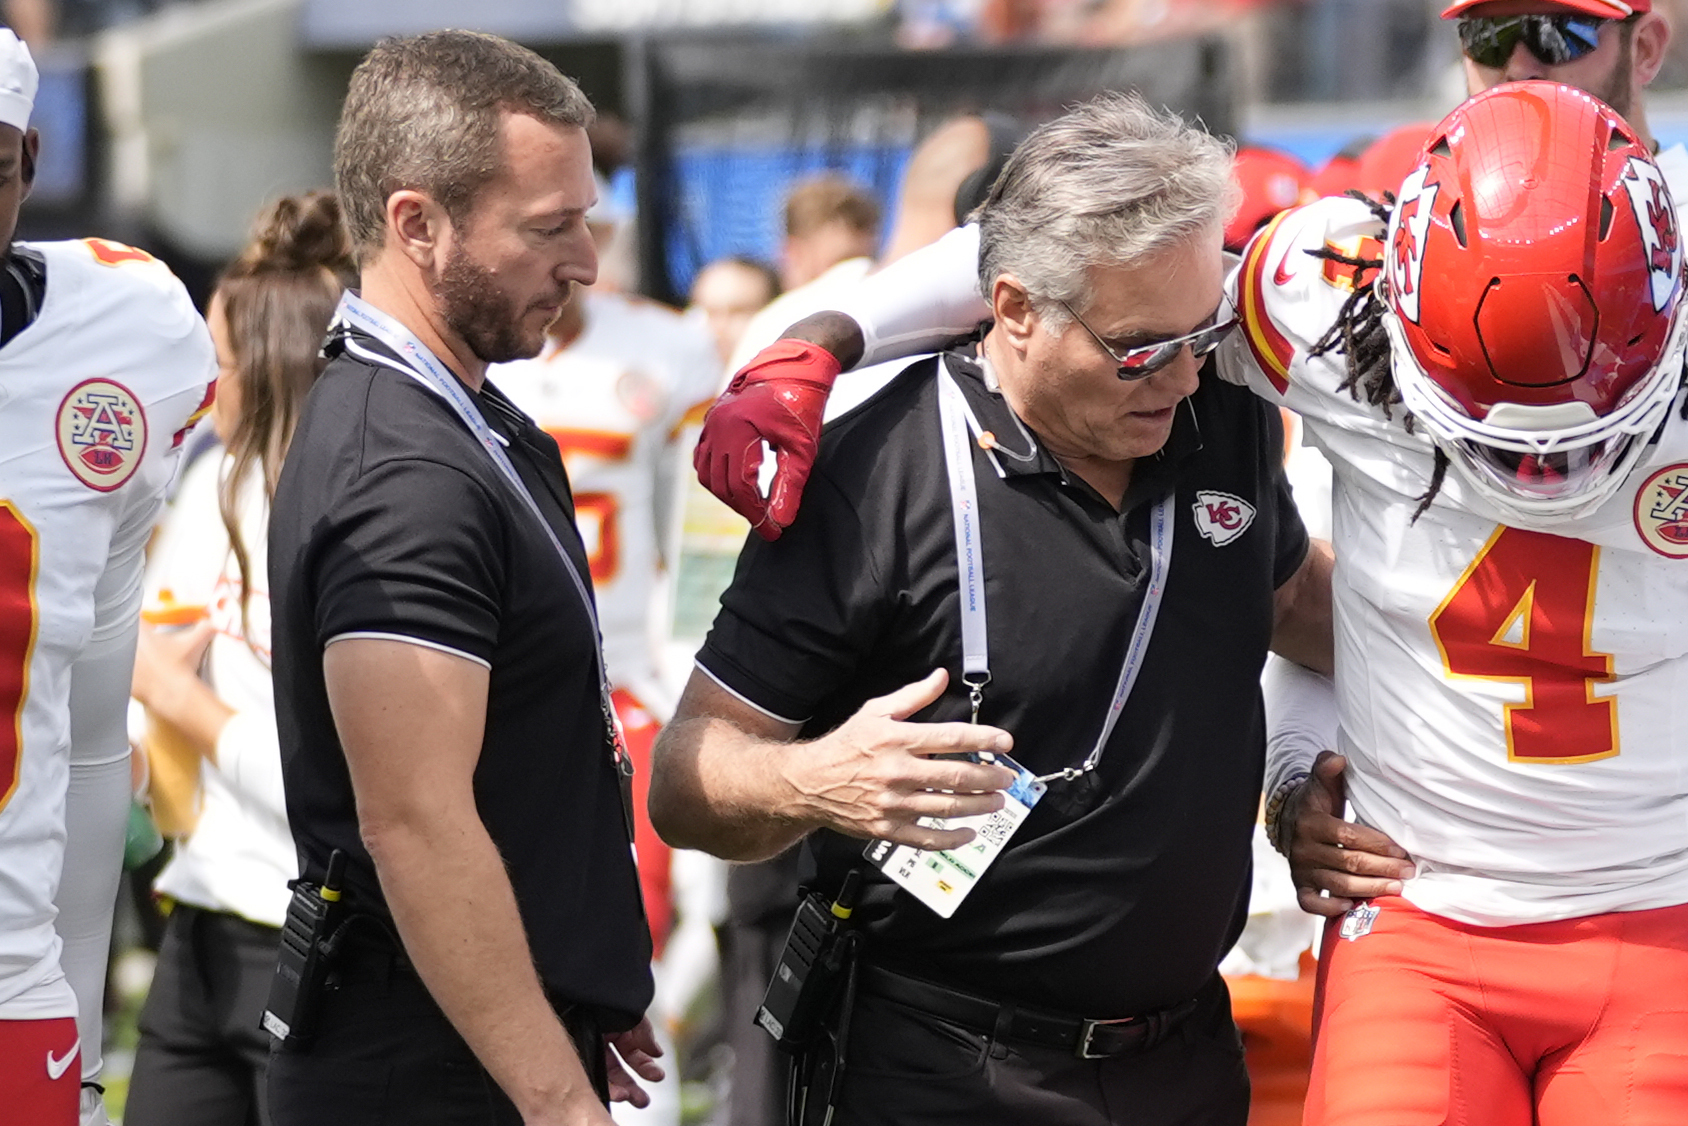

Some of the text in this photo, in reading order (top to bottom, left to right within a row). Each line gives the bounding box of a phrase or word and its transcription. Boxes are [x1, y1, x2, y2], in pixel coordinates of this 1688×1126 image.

[414, 352, 482, 431] NATIONAL FOOTBALL LEAGUE
[963, 513, 973, 547] NATIONAL
[1205, 501, 1243, 530] KC
[966, 547, 976, 582] FOOTBALL
[1428, 523, 1621, 765] 4
